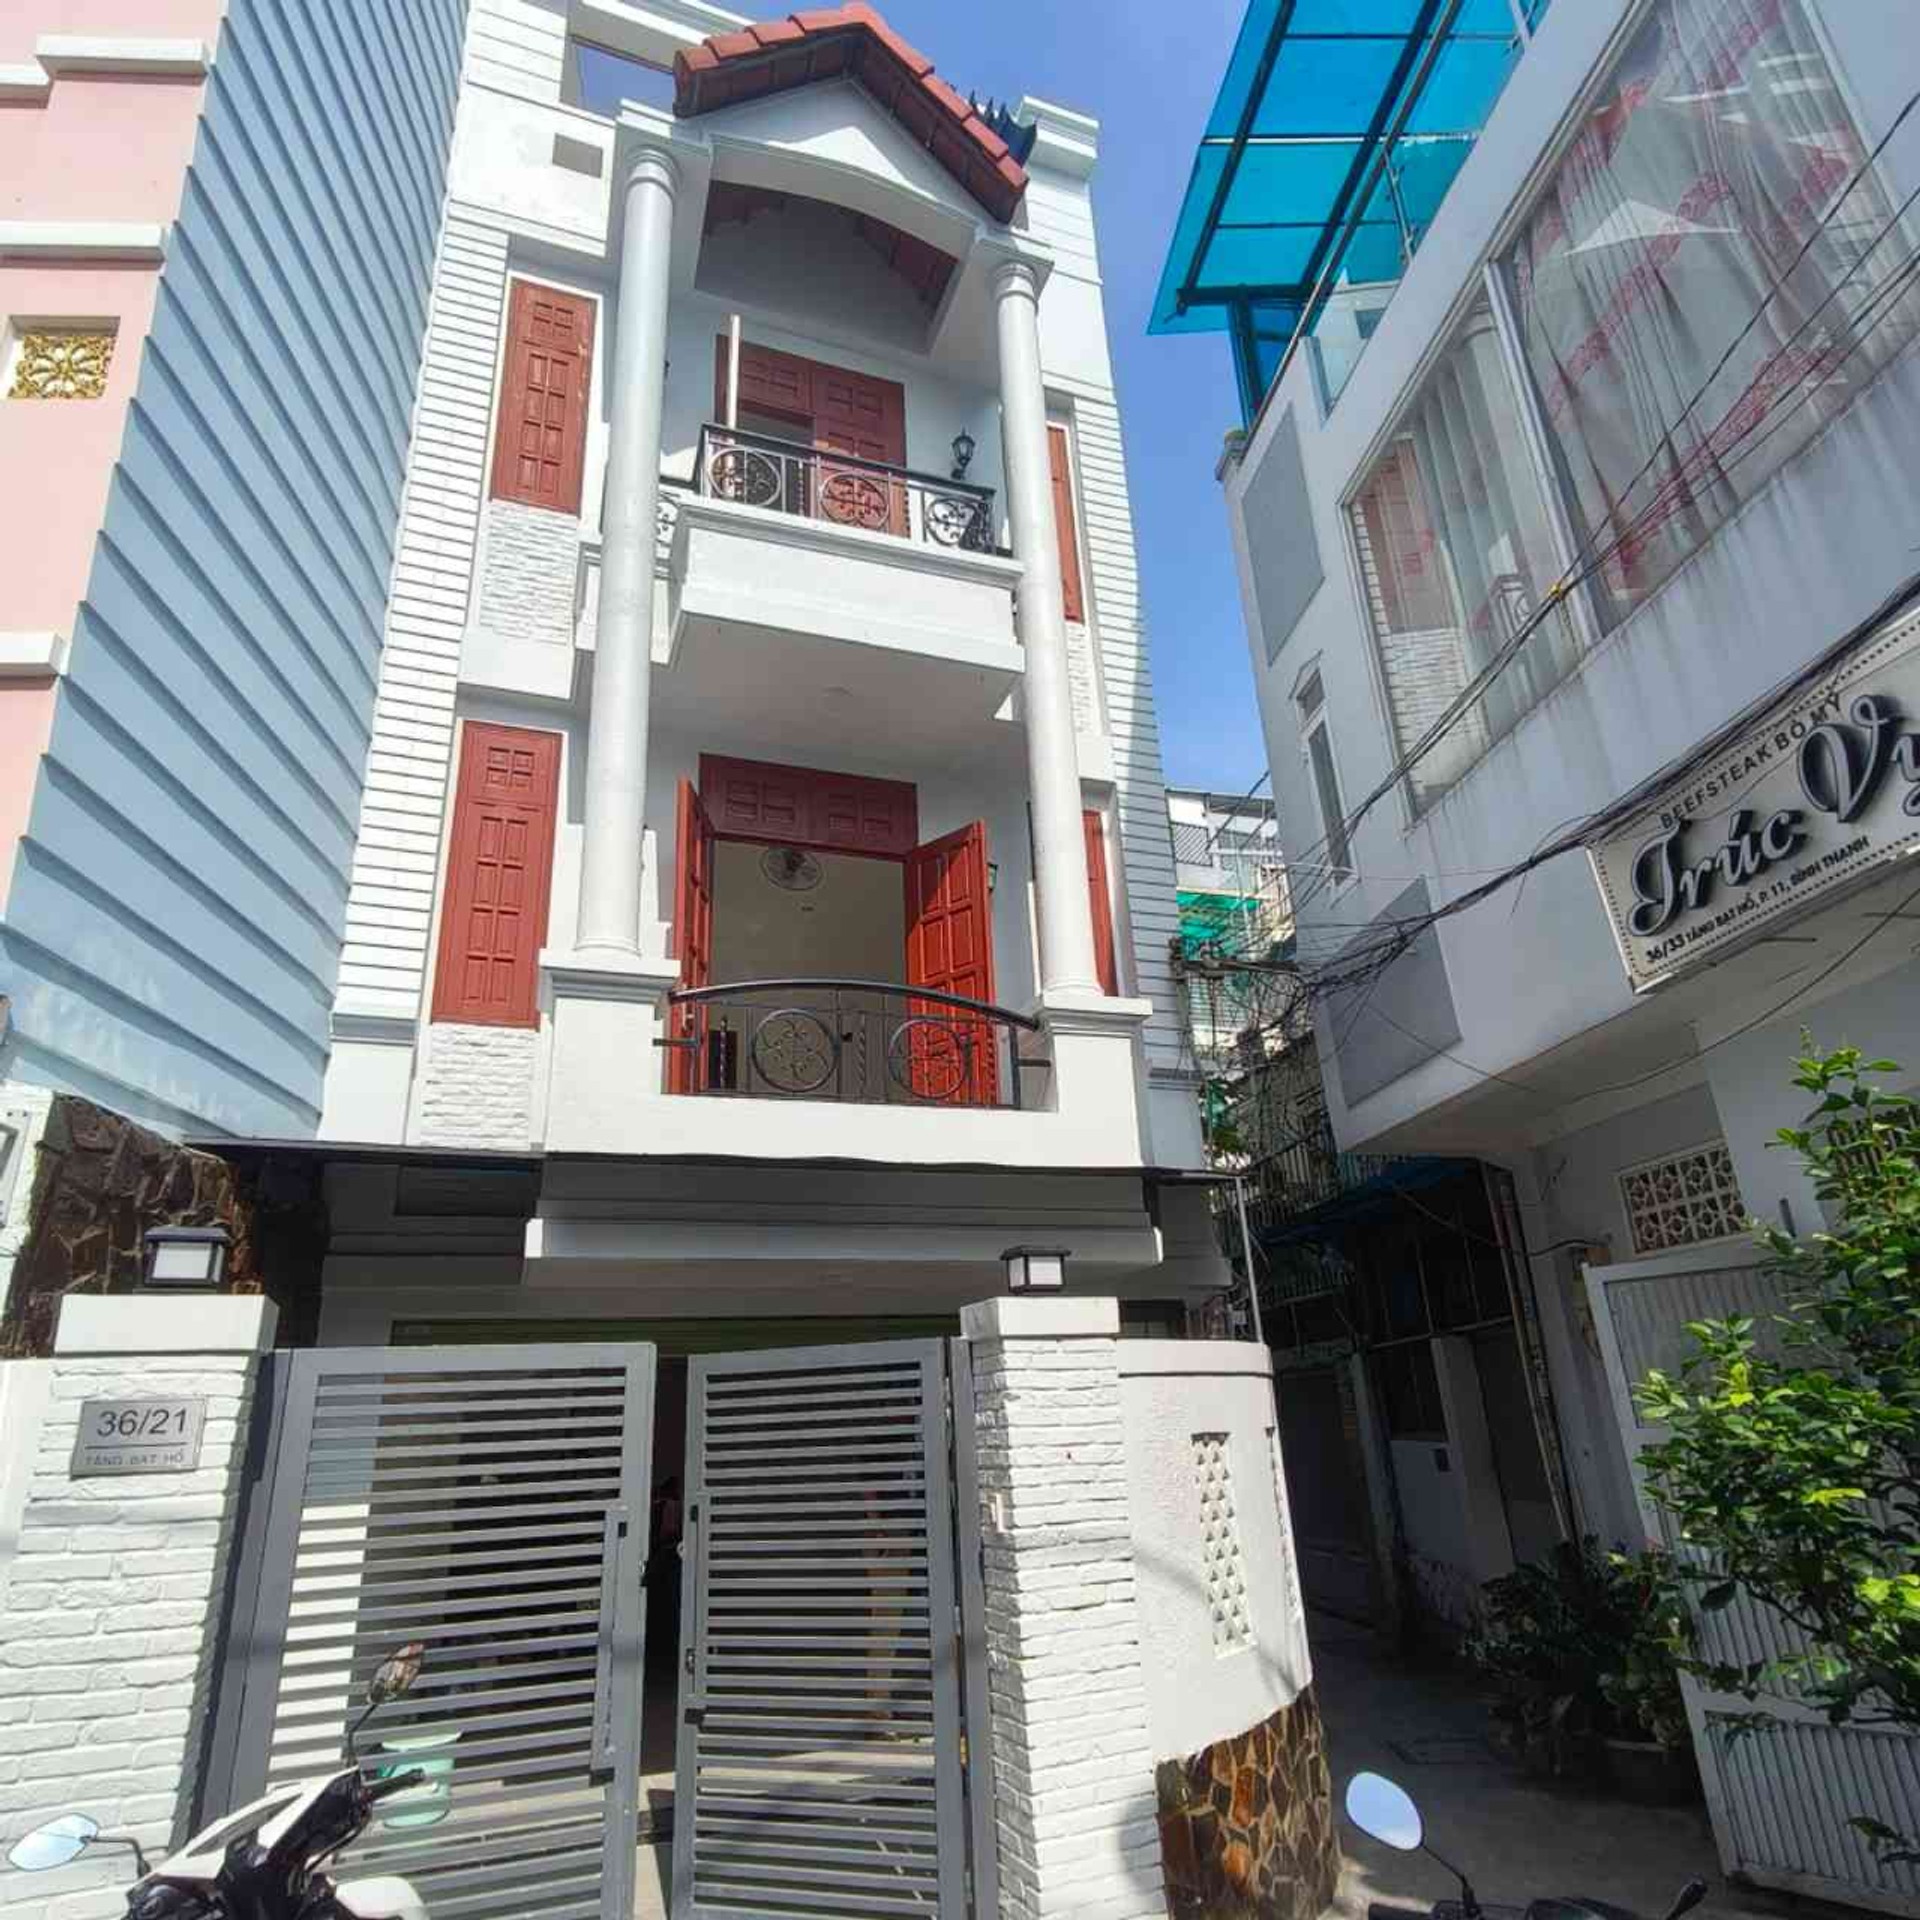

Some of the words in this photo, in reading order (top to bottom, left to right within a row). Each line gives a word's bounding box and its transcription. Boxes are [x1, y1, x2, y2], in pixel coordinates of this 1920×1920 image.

[1659, 744, 1774, 830] BEEFSTEAK
[1774, 719, 1806, 751] BÒ
[1627, 809, 1804, 937] Trúc
[97, 1408, 187, 1437] 36/21
